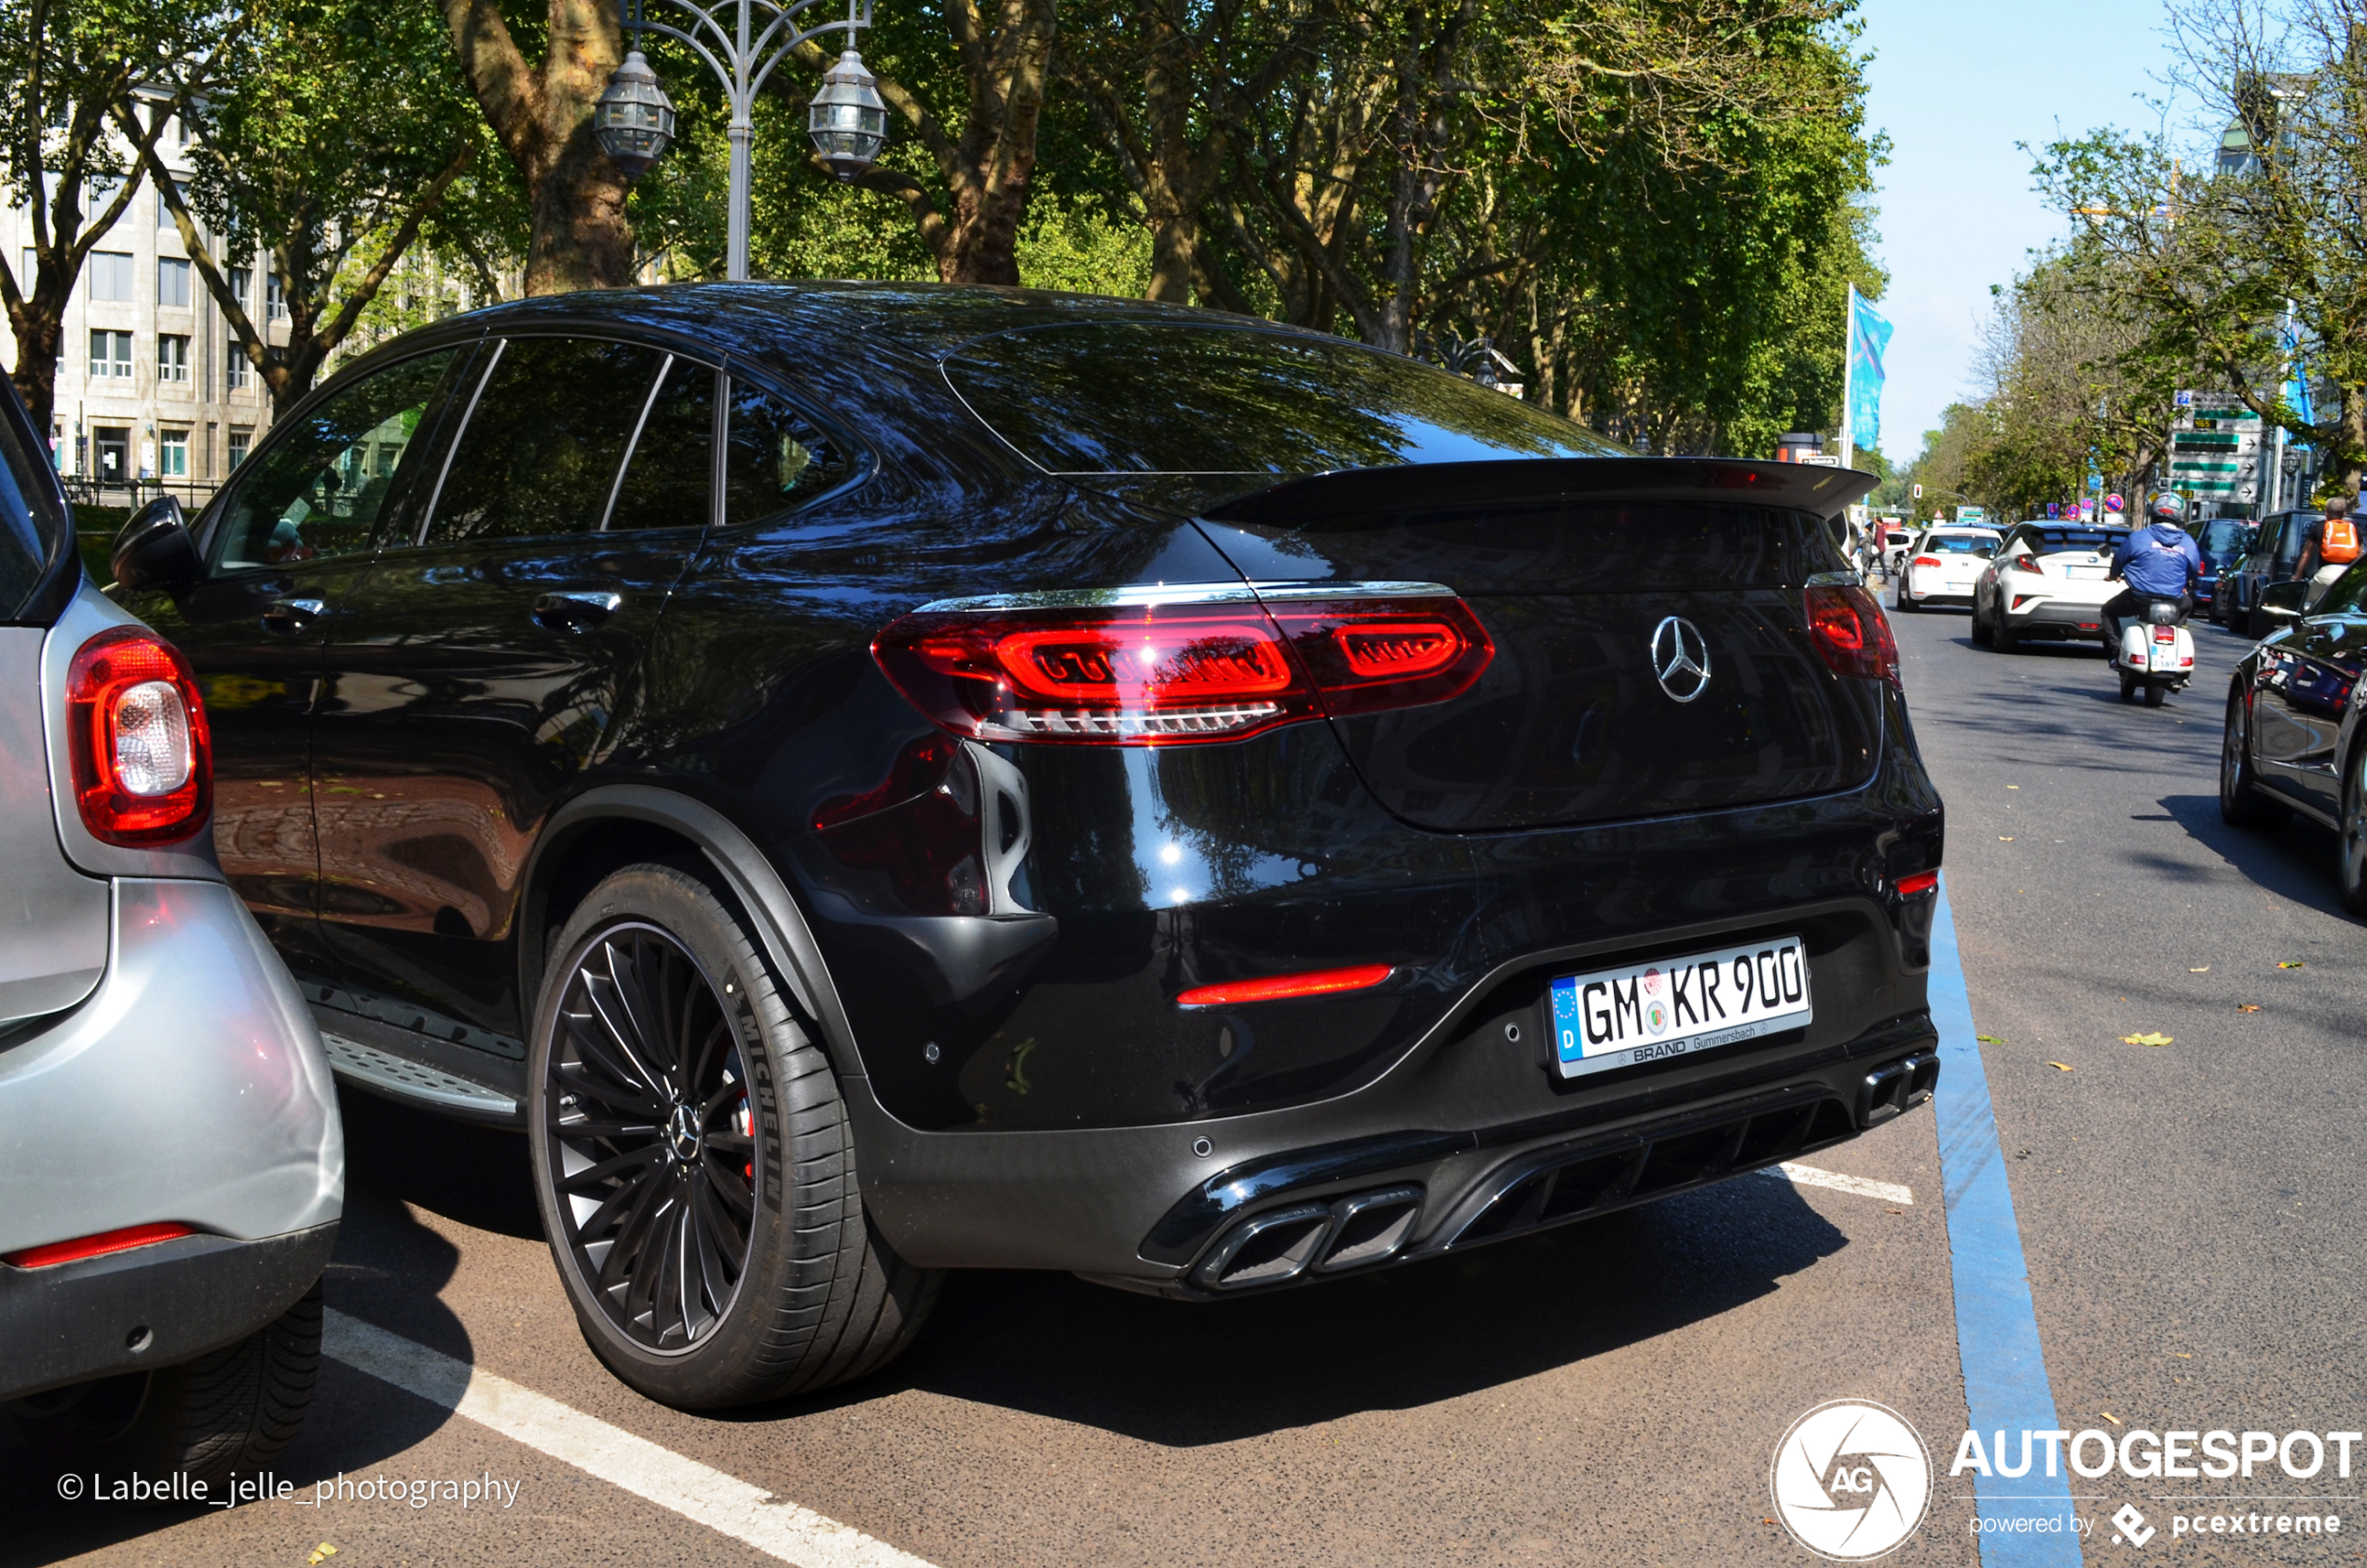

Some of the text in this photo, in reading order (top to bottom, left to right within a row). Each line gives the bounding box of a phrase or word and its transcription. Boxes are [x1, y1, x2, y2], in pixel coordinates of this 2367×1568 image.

[2195, 419, 2210, 428] 465
[1582, 945, 1803, 1045] GM KR 900
[1562, 1029, 1575, 1049] D
[1634, 1026, 1756, 1063] BRAND Gummersbach
[740, 1013, 781, 1203] MICHELIN
